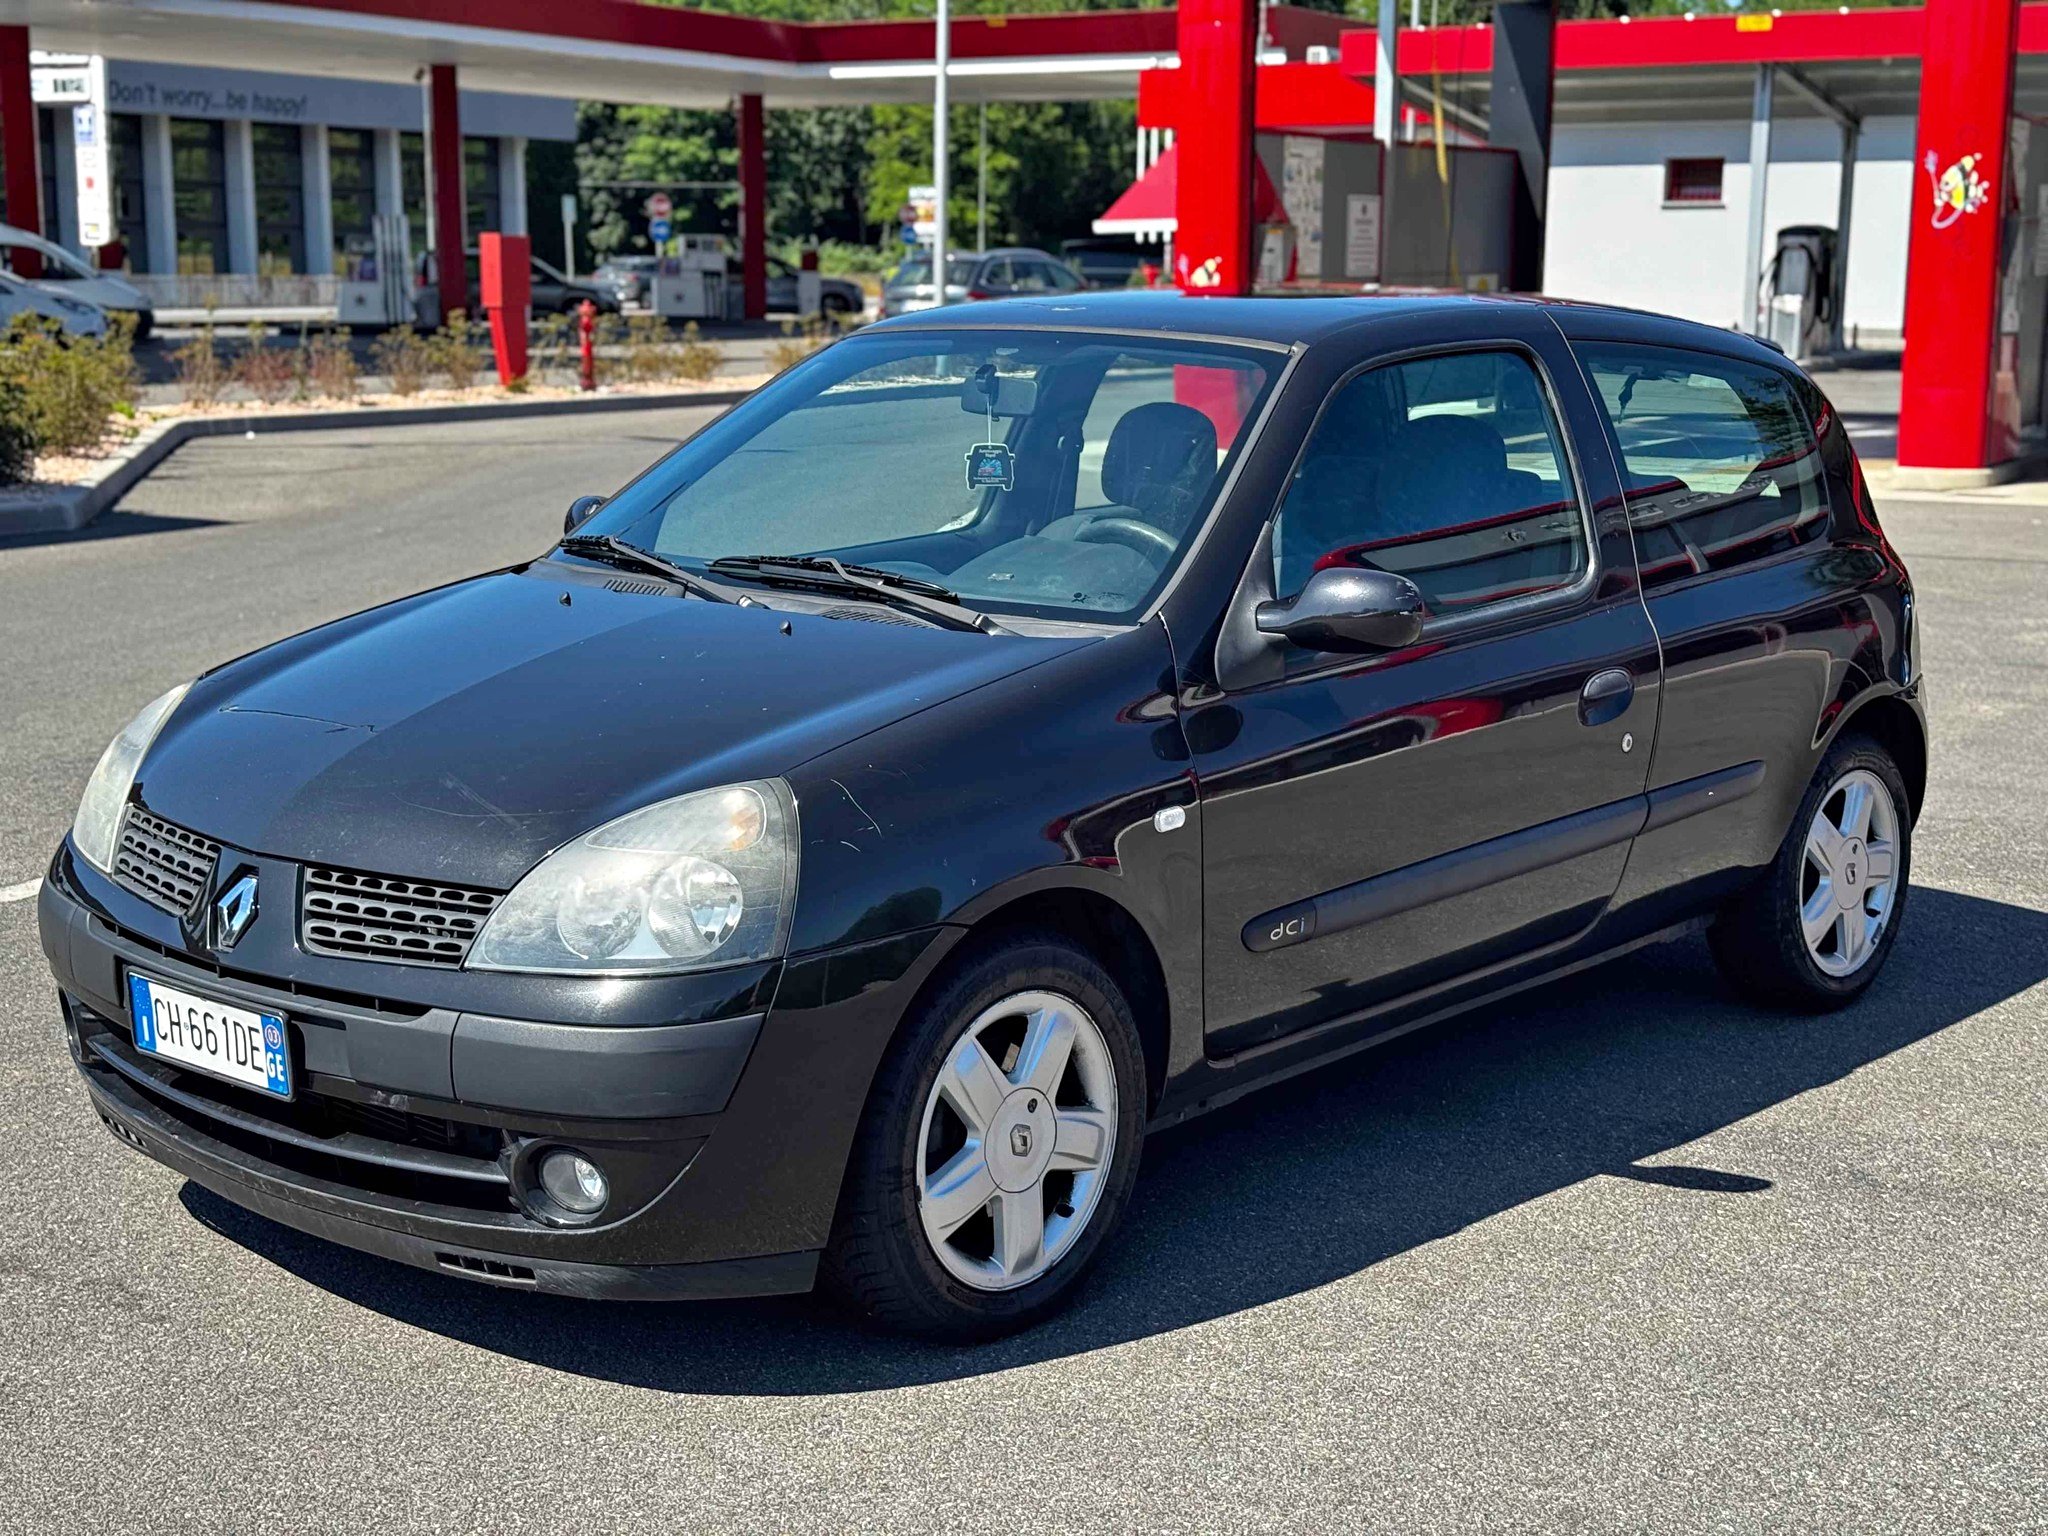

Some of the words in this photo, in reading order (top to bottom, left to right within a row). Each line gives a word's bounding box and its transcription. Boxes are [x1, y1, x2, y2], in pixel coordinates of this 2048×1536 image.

[109, 79, 156, 103] Don't
[252, 91, 308, 118] happy!
[267, 1029, 279, 1044] 03
[266, 1051, 285, 1082] GE
